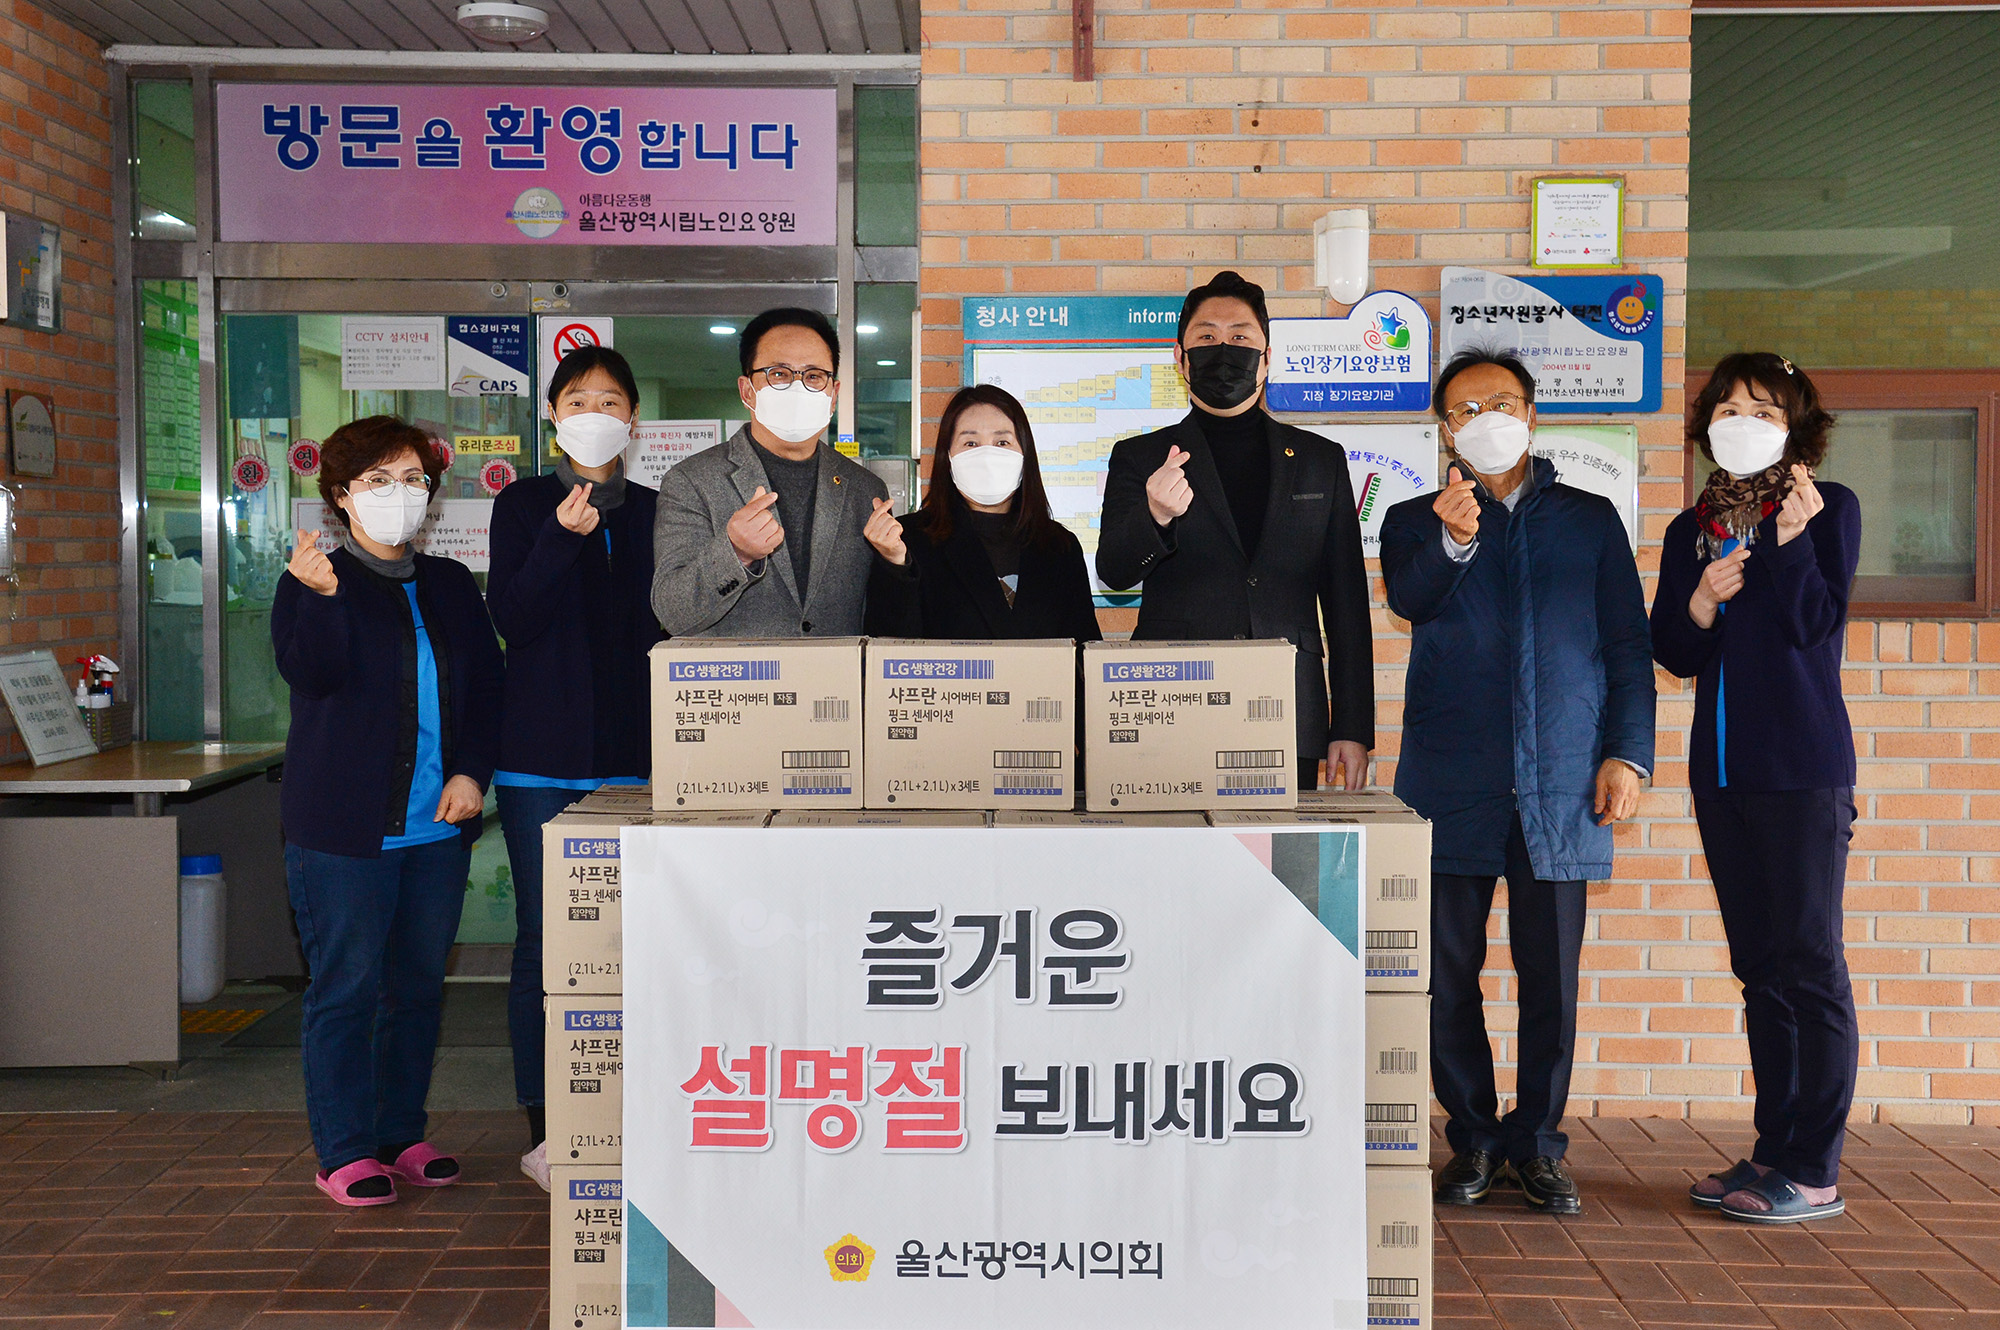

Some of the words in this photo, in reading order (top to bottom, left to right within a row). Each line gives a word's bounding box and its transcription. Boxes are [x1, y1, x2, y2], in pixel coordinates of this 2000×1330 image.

[262, 103, 462, 171] 방문을
[484, 103, 800, 175] 환영합니다
[579, 193, 652, 207] 아름다운동행
[578, 210, 796, 233] 울산광역시립노인요양원
[976, 306, 1020, 328] 청사
[1026, 306, 1068, 327] 안내
[1450, 304, 1564, 324] 청소년자원봉사
[458, 324, 520, 334] 캡스경비구역
[355, 332, 384, 342] CCTV
[390, 332, 429, 344] 설치안내
[1285, 354, 1411, 374] 노인장기요양보험
[480, 380, 518, 392] CAPS
[1303, 390, 1324, 402] 지정
[1330, 390, 1394, 402] 장기요양기관
[660, 432, 682, 440] 확진자
[684, 432, 714, 440] 예방차원
[459, 439, 516, 452] 유리문조심
[296, 448, 313, 470] 영
[1559, 450, 1580, 462] 우수
[1583, 454, 1622, 480] 인증센터
[240, 464, 260, 485] 환
[490, 467, 508, 488] 다
[1360, 476, 1382, 522] VOLUNTEER
[675, 690, 724, 708] 샤프란
[727, 692, 768, 706] 시어버터
[776, 693, 794, 704] 자동
[888, 687, 936, 705] 샤프란
[940, 692, 982, 705] 시어버터
[989, 693, 1007, 704] 자동
[1109, 690, 1157, 708] 샤프란
[1161, 693, 1202, 706] 시어버터
[1210, 694, 1228, 704] 자동
[675, 711, 696, 726] 핑크
[699, 710, 741, 724] 센세이션
[888, 709, 909, 723] 핑크
[912, 709, 954, 723] 센세이션
[1109, 712, 1130, 726] 핑크
[1133, 712, 1175, 725] 센세이션
[677, 730, 702, 741] 절약형
[890, 728, 915, 738] 절약형
[1111, 731, 1136, 742] 절약형
[569, 866, 620, 884] 샤프란
[569, 889, 590, 903] 핑크
[571, 908, 596, 919] 절약형
[861, 909, 1128, 1007] 즐거운
[570, 1038, 621, 1057] 샤프란
[570, 1062, 592, 1076] 핑크
[572, 1081, 598, 1092] 절약형
[679, 1044, 967, 1150] 설명절
[995, 1059, 1307, 1142] 보내세요
[575, 1232, 596, 1245] 핑크
[576, 1251, 602, 1261] 절약형
[836, 1253, 862, 1266] 의회
[896, 1240, 1163, 1280] 울산광역시의회
